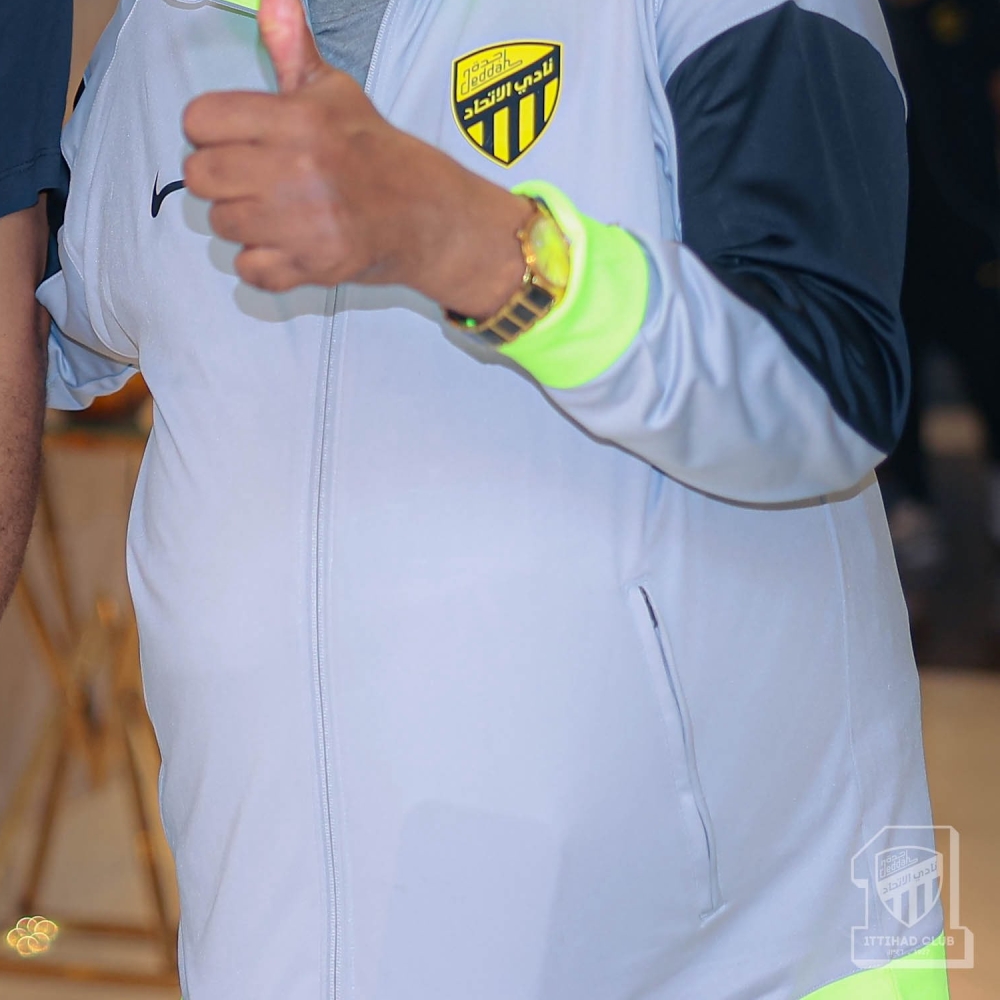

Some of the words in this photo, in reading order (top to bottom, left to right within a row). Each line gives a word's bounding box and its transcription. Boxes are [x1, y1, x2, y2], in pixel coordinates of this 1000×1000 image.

[460, 49, 523, 95] Jeddah
[514, 57, 554, 96] نادي
[464, 81, 511, 121] الاتحاد
